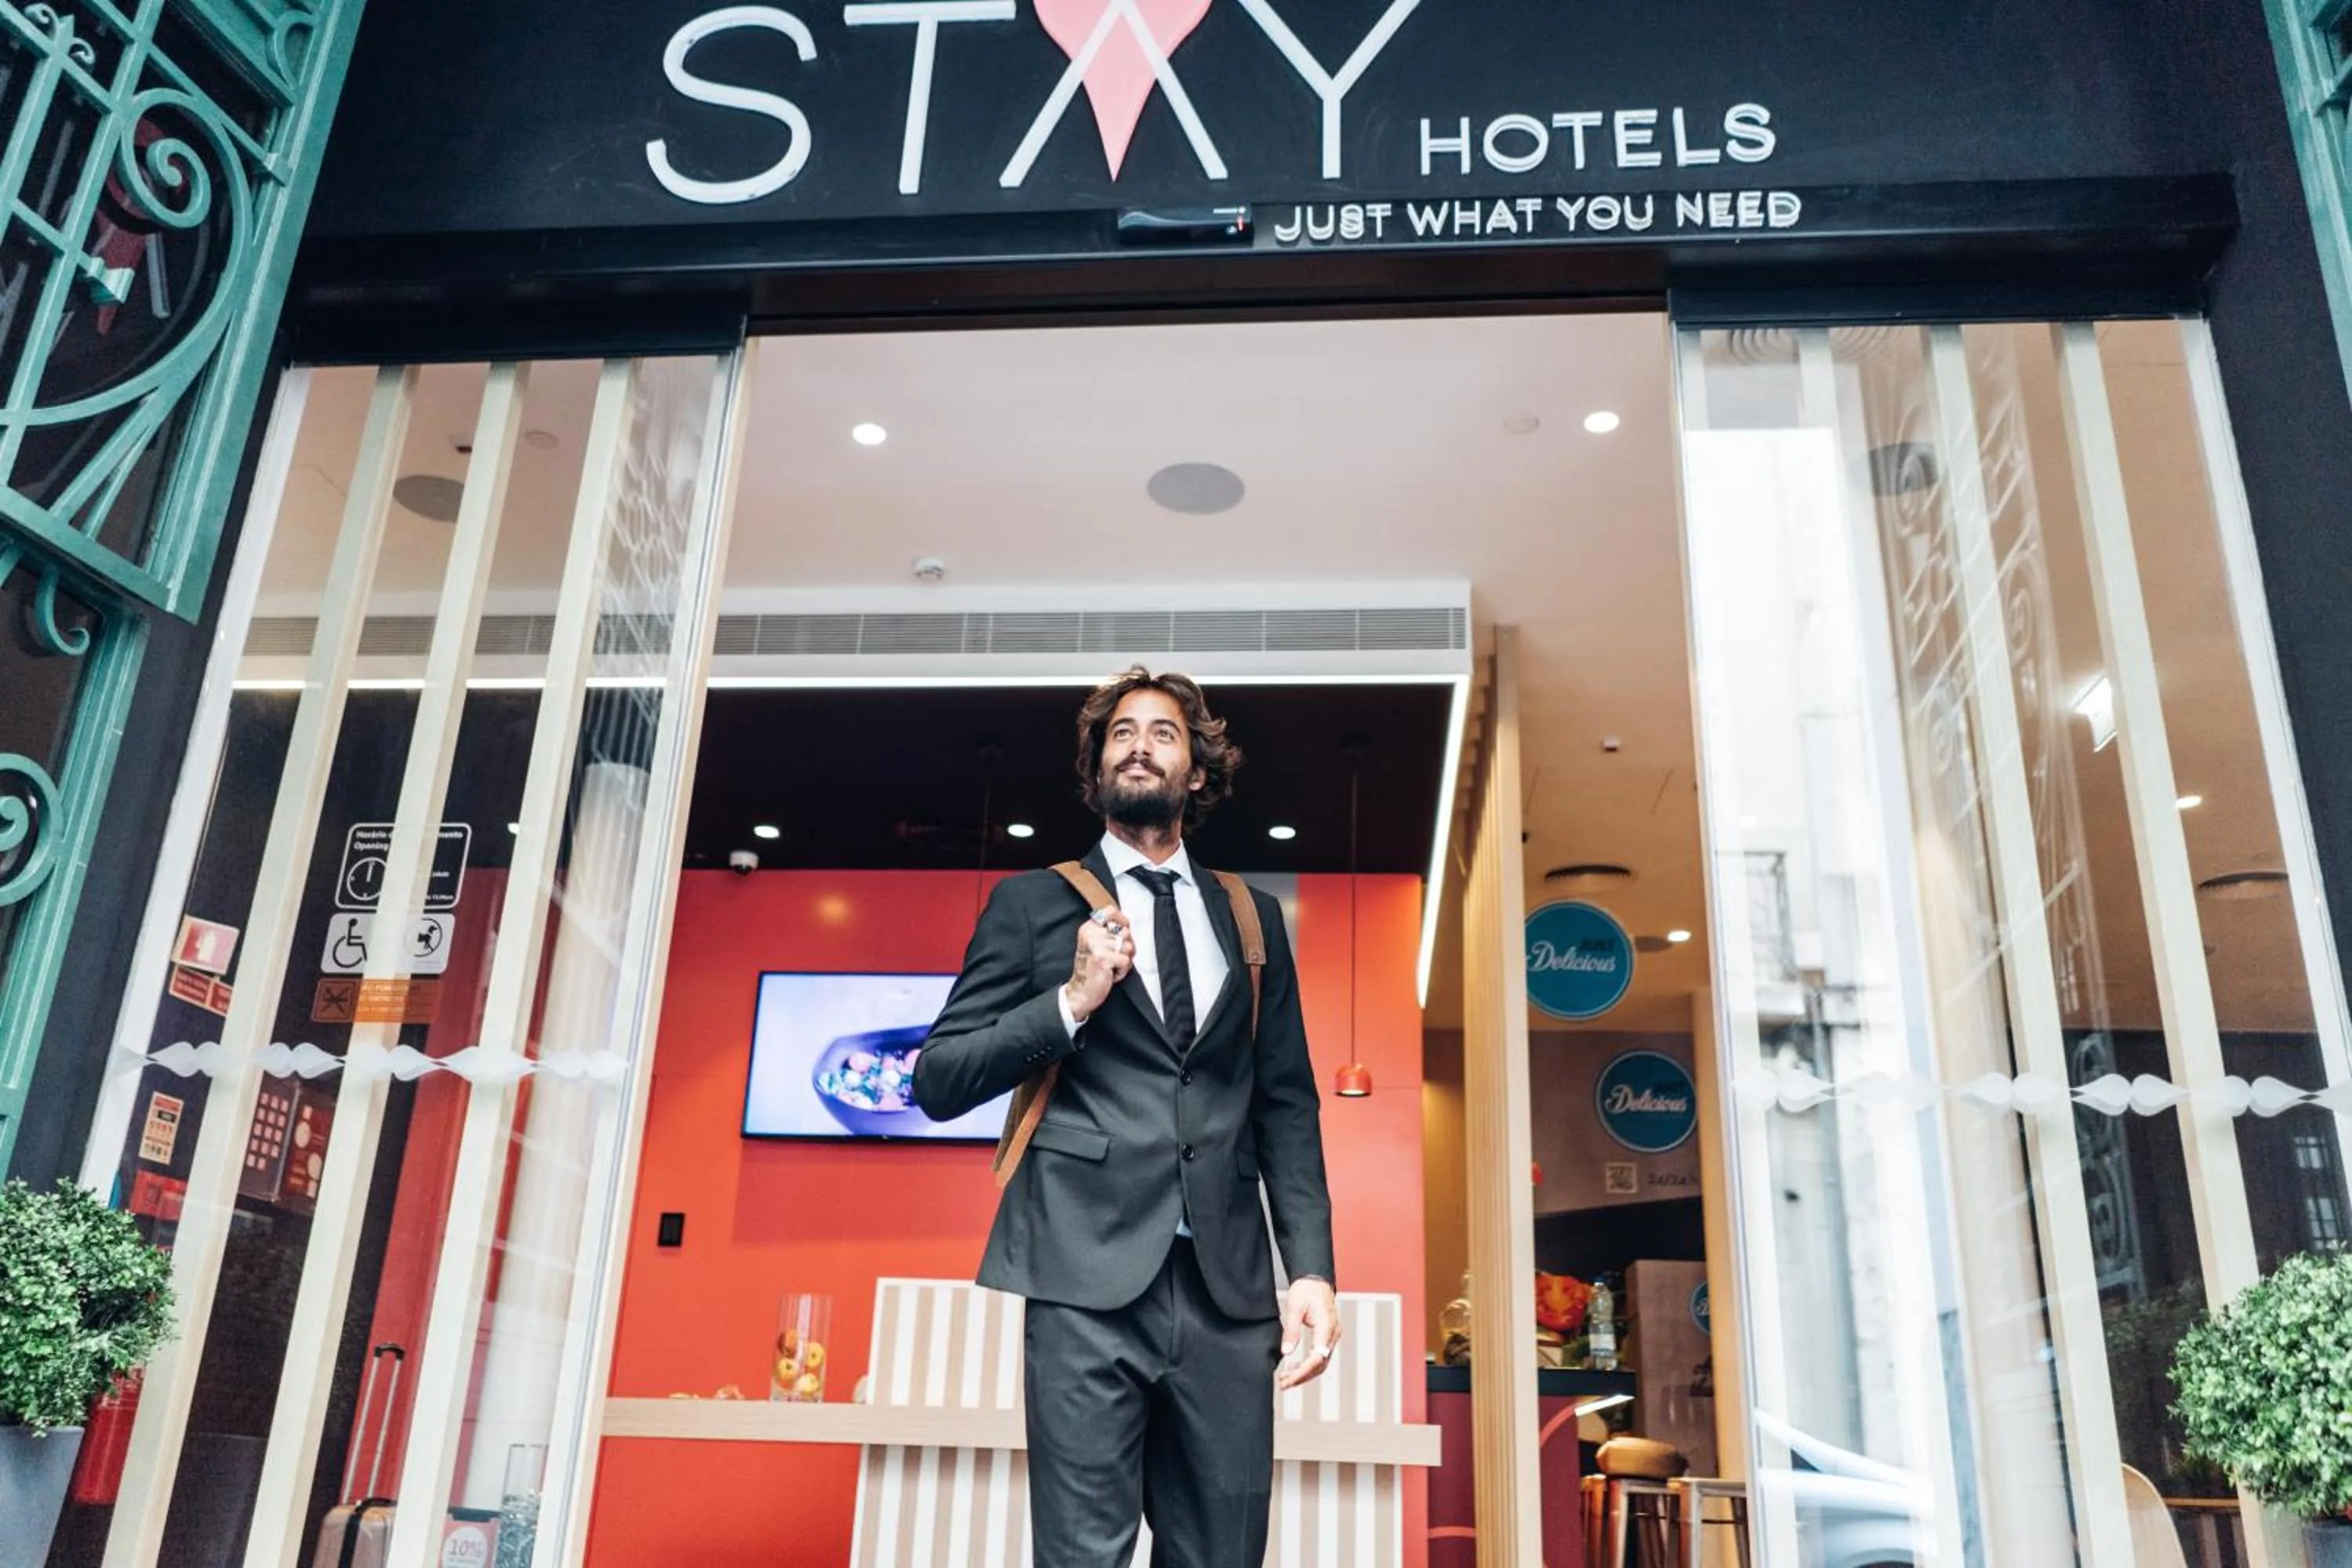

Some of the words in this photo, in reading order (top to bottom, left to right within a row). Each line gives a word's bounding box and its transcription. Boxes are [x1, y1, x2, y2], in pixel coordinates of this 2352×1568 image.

[645, 0, 1417, 203] STAY
[1419, 103, 1777, 176] HOTELS
[1274, 201, 1392, 242] JUST
[1408, 198, 1543, 236] WHAT
[1556, 194, 1654, 232] YOU
[1676, 191, 1802, 229] NEED
[1528, 940, 1617, 973] Delicious
[1605, 1083, 1688, 1114] Delicious
